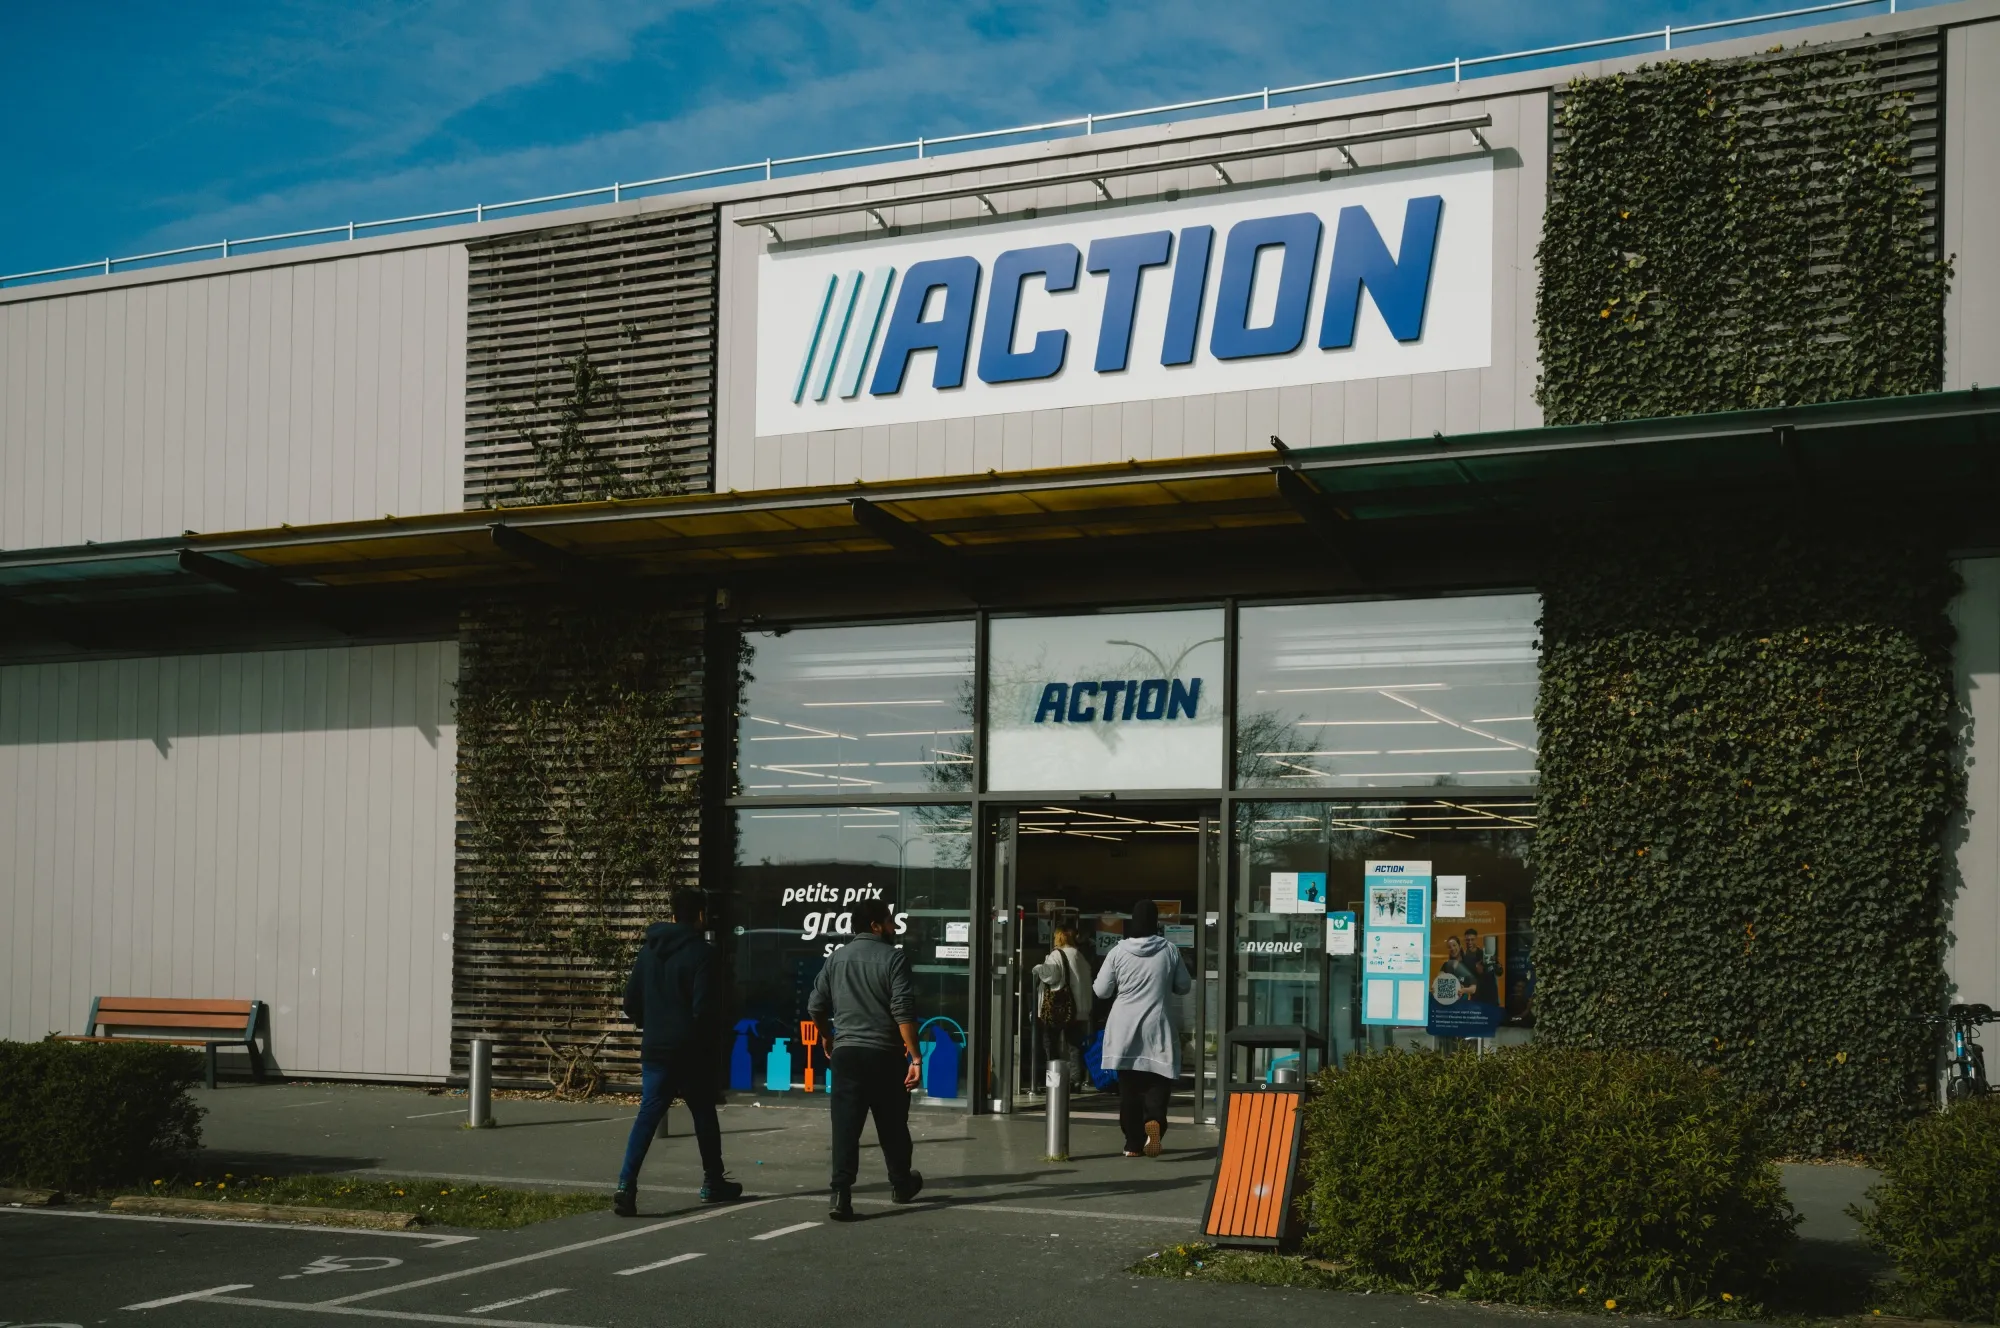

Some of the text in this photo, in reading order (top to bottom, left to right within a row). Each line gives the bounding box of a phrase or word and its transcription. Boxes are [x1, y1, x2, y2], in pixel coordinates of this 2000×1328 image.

[869, 194, 1444, 395] ACTION
[1034, 677, 1203, 723] ACTION
[1374, 865, 1405, 873] ACTION
[782, 883, 883, 907] petits prix
[802, 904, 908, 941] gras
